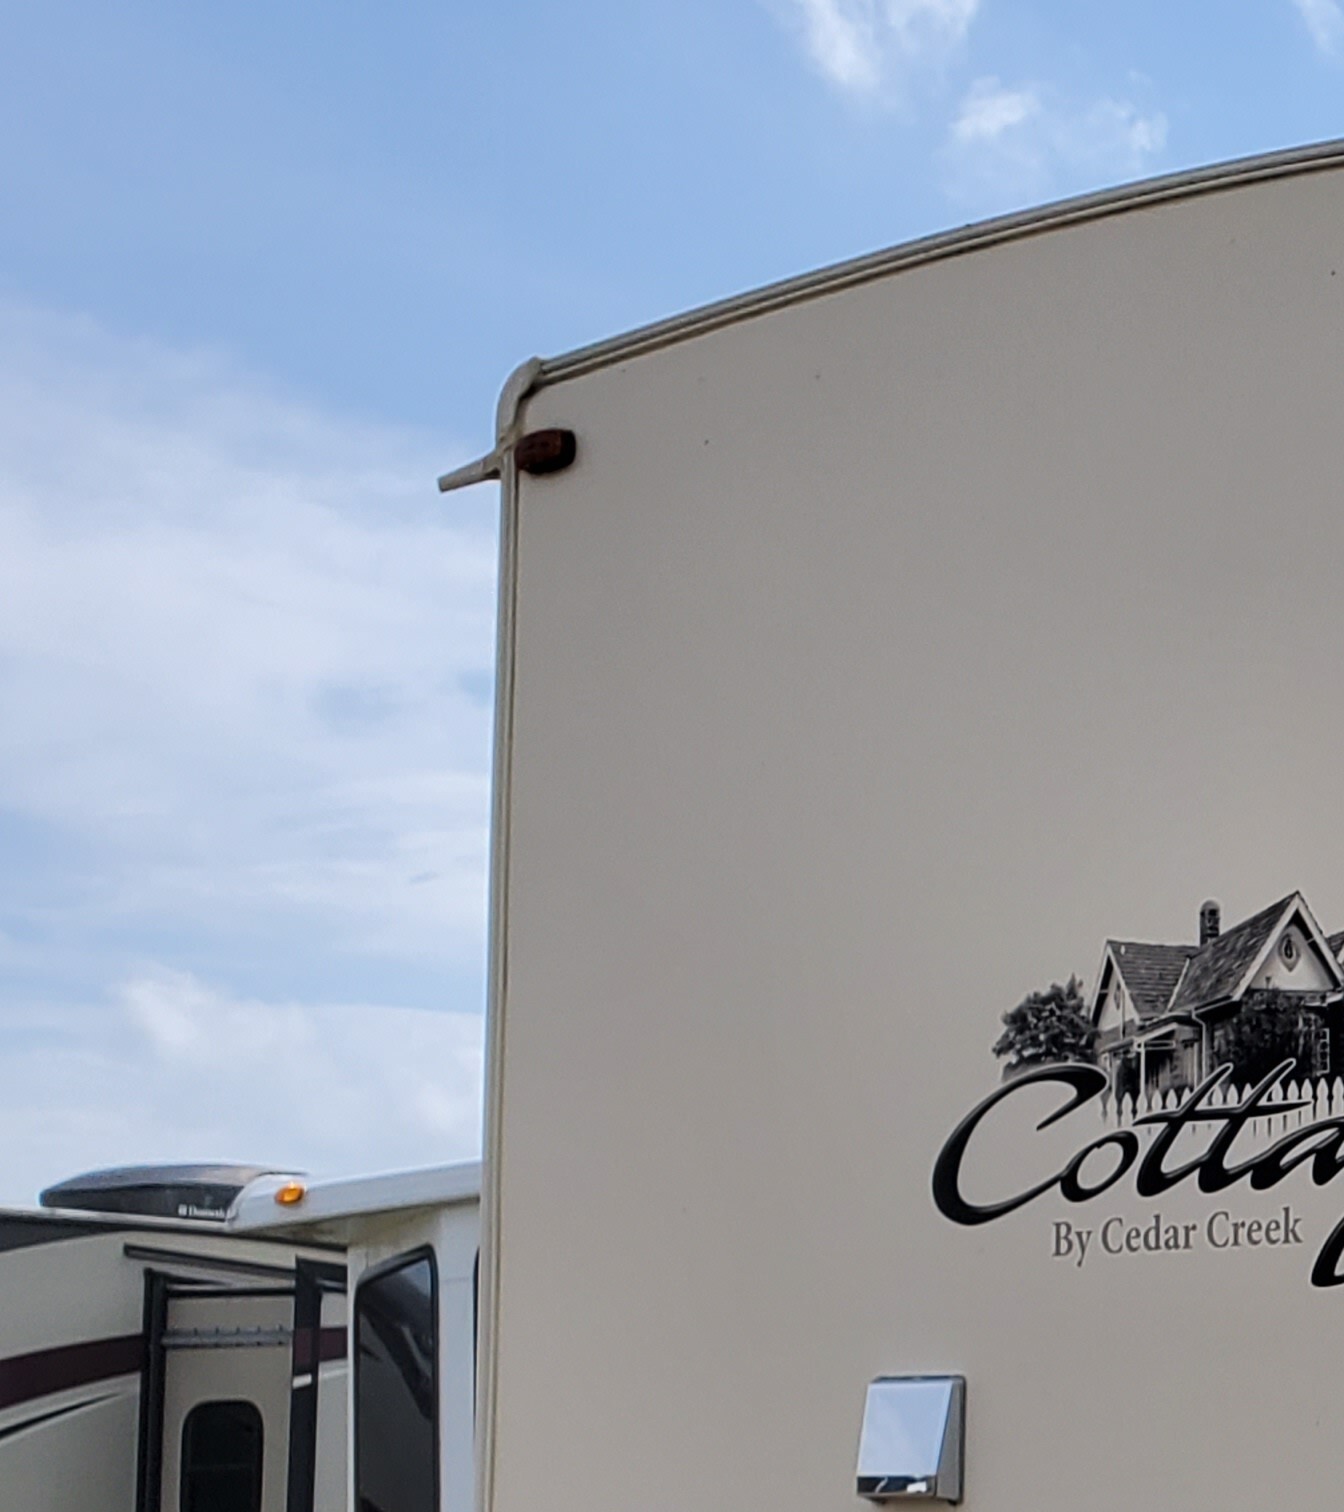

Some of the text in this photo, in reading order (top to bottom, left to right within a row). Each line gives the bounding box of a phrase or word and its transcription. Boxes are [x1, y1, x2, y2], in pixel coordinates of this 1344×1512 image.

[1052, 1206, 1303, 1268] By Cedar Creek
